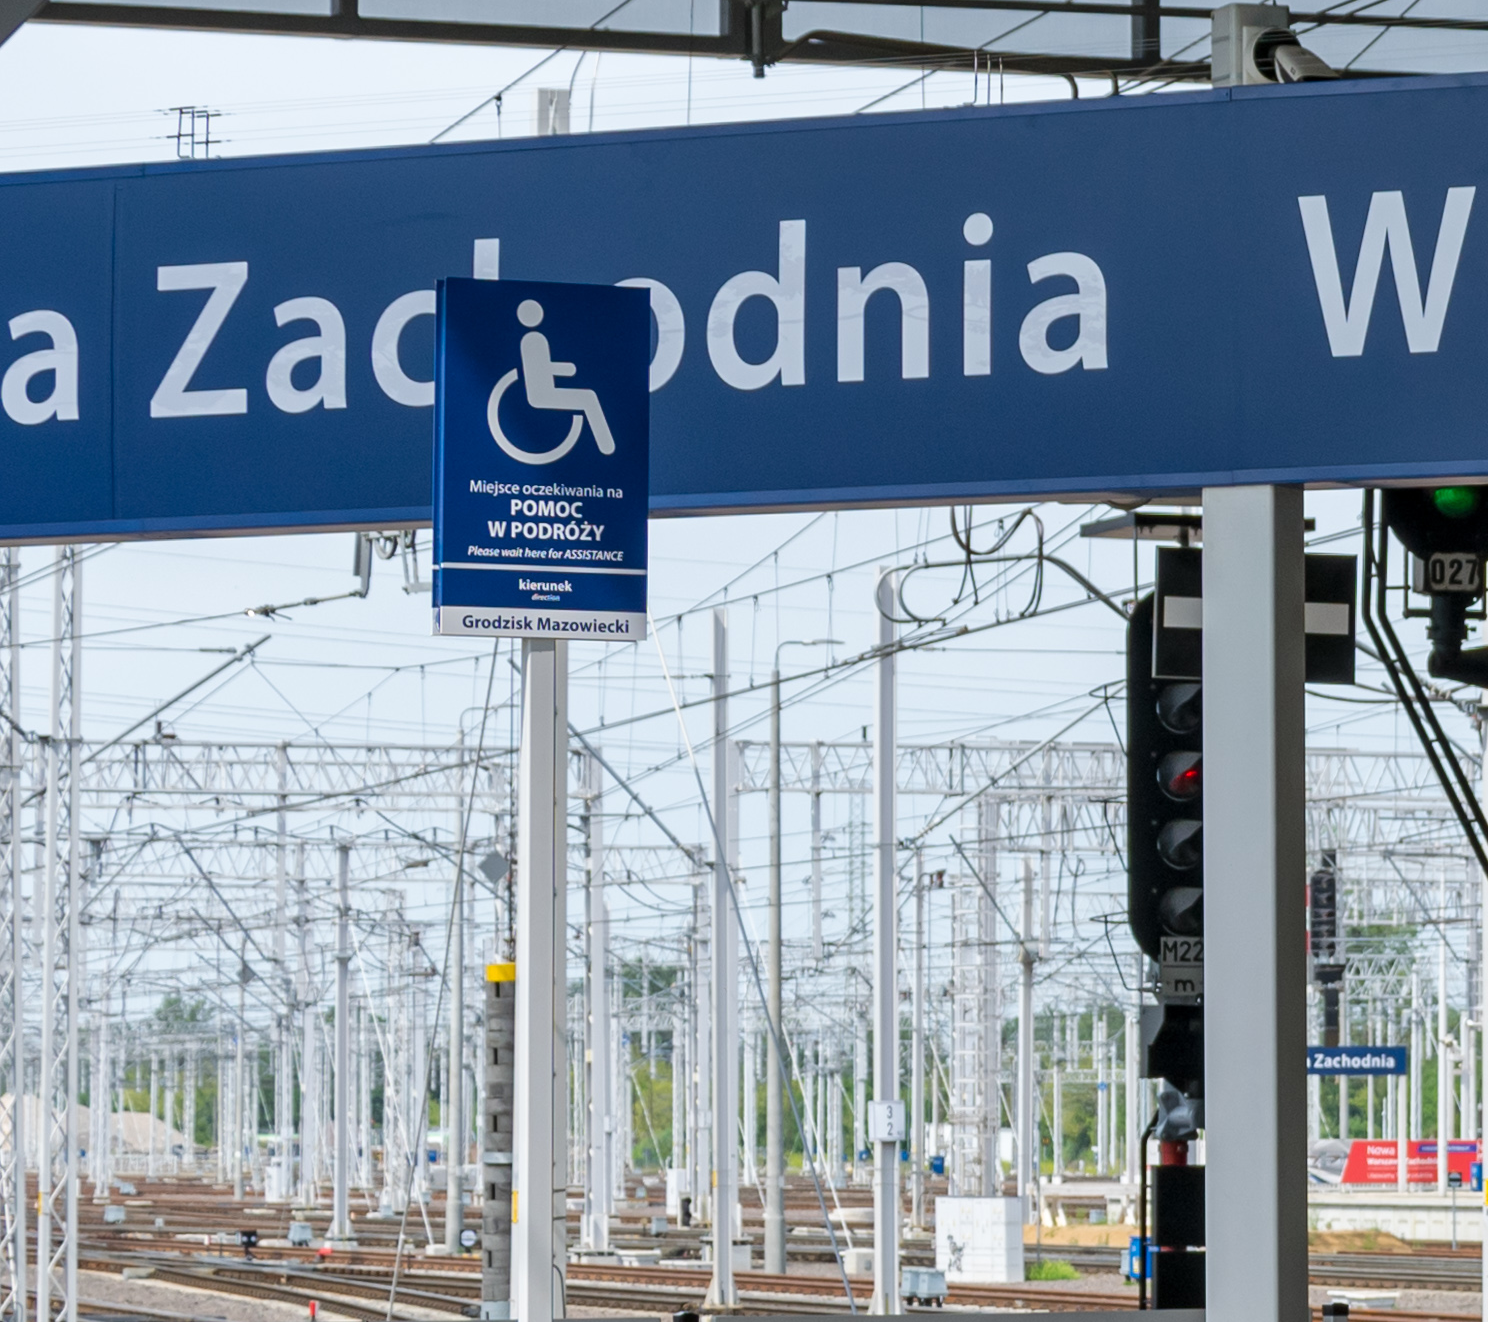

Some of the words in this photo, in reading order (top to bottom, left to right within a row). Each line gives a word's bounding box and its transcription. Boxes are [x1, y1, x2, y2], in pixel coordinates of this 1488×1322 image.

[149, 212, 1111, 421] Zacdnia
[469, 480, 520, 496] Miejsce
[522, 483, 604, 498] oczekiwania
[606, 488, 623, 498] na
[510, 499, 583, 518] POMOC
[487, 520, 506, 538] W
[510, 520, 604, 541] PODRÓŻY
[467, 545, 500, 557] Please
[501, 547, 522, 558] wait
[524, 547, 547, 559] here
[548, 548, 563, 559] for
[563, 549, 624, 562] ASSISTANCE
[518, 578, 572, 592] kierunek
[462, 614, 533, 630] Grodzisk
[536, 616, 629, 634] Mazowiecki
[1313, 1052, 1396, 1069] Zachodnia
